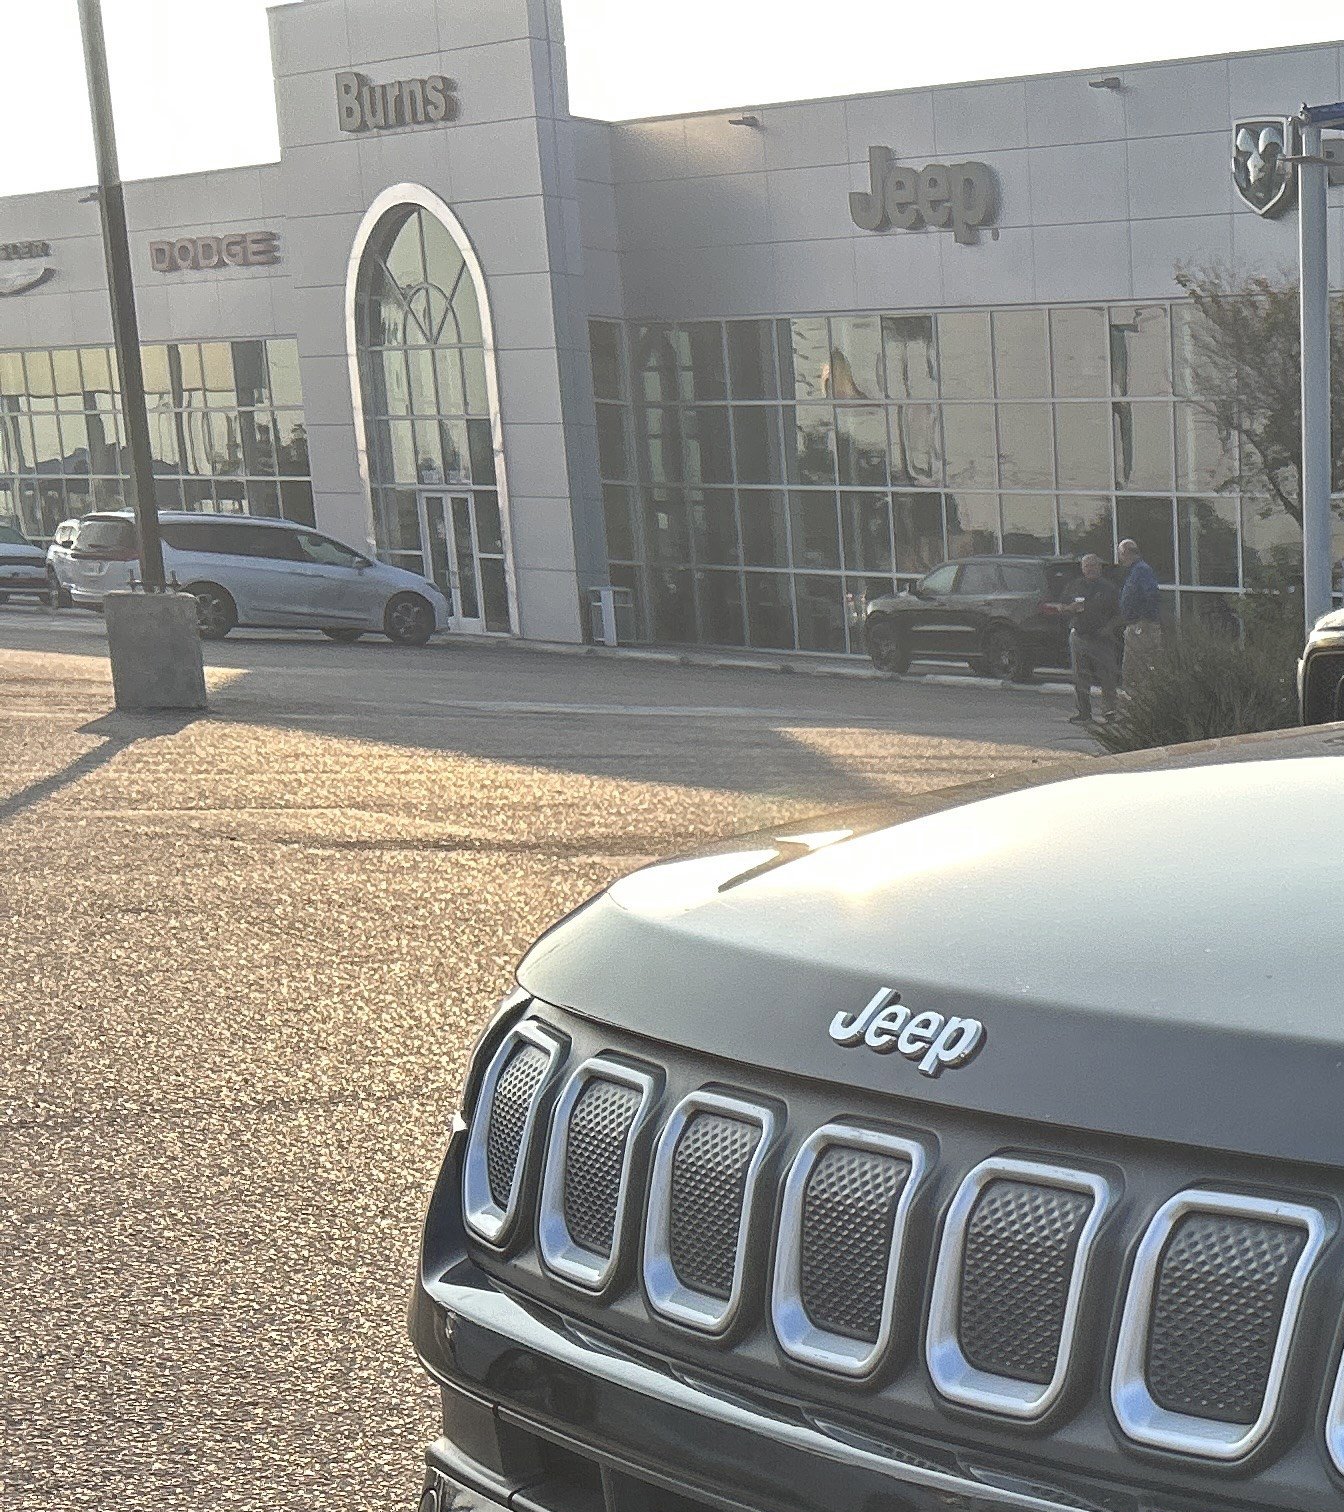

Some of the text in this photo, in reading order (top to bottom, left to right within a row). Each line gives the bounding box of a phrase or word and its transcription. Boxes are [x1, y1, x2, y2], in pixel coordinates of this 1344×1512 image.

[335, 72, 460, 133] Burns
[848, 145, 1003, 245] Jeep
[149, 231, 281, 273] DODGE
[828, 986, 987, 1079] Jeep
